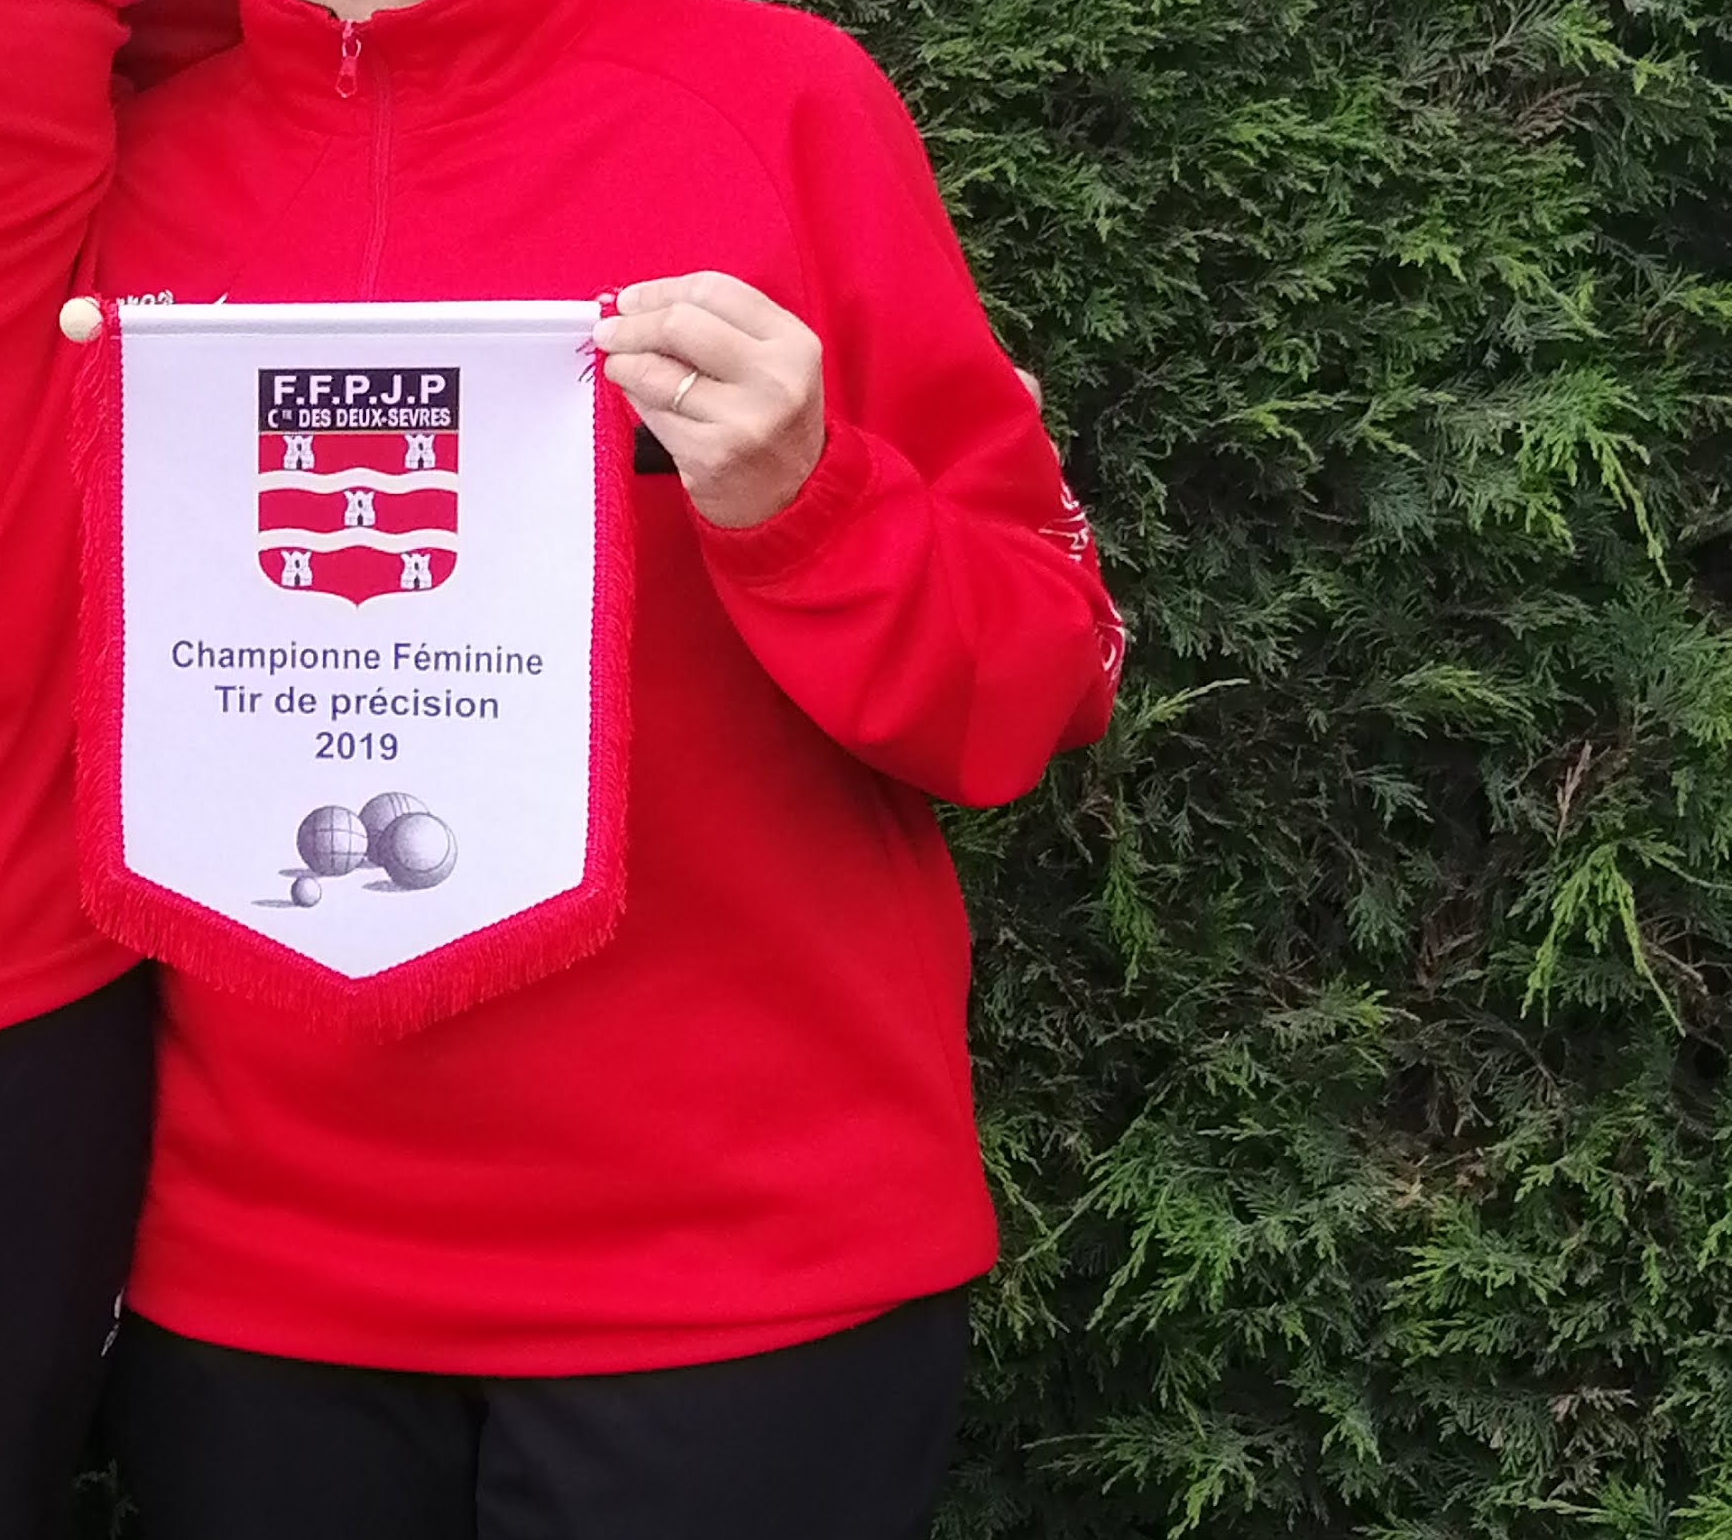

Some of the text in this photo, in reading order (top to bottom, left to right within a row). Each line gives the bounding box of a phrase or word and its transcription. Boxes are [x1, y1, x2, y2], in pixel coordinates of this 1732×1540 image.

[299, 409, 331, 428] DES
[172, 640, 544, 675] Championne Féminine
[215, 685, 499, 721] Tir de précision
[315, 731, 399, 760] 2019
